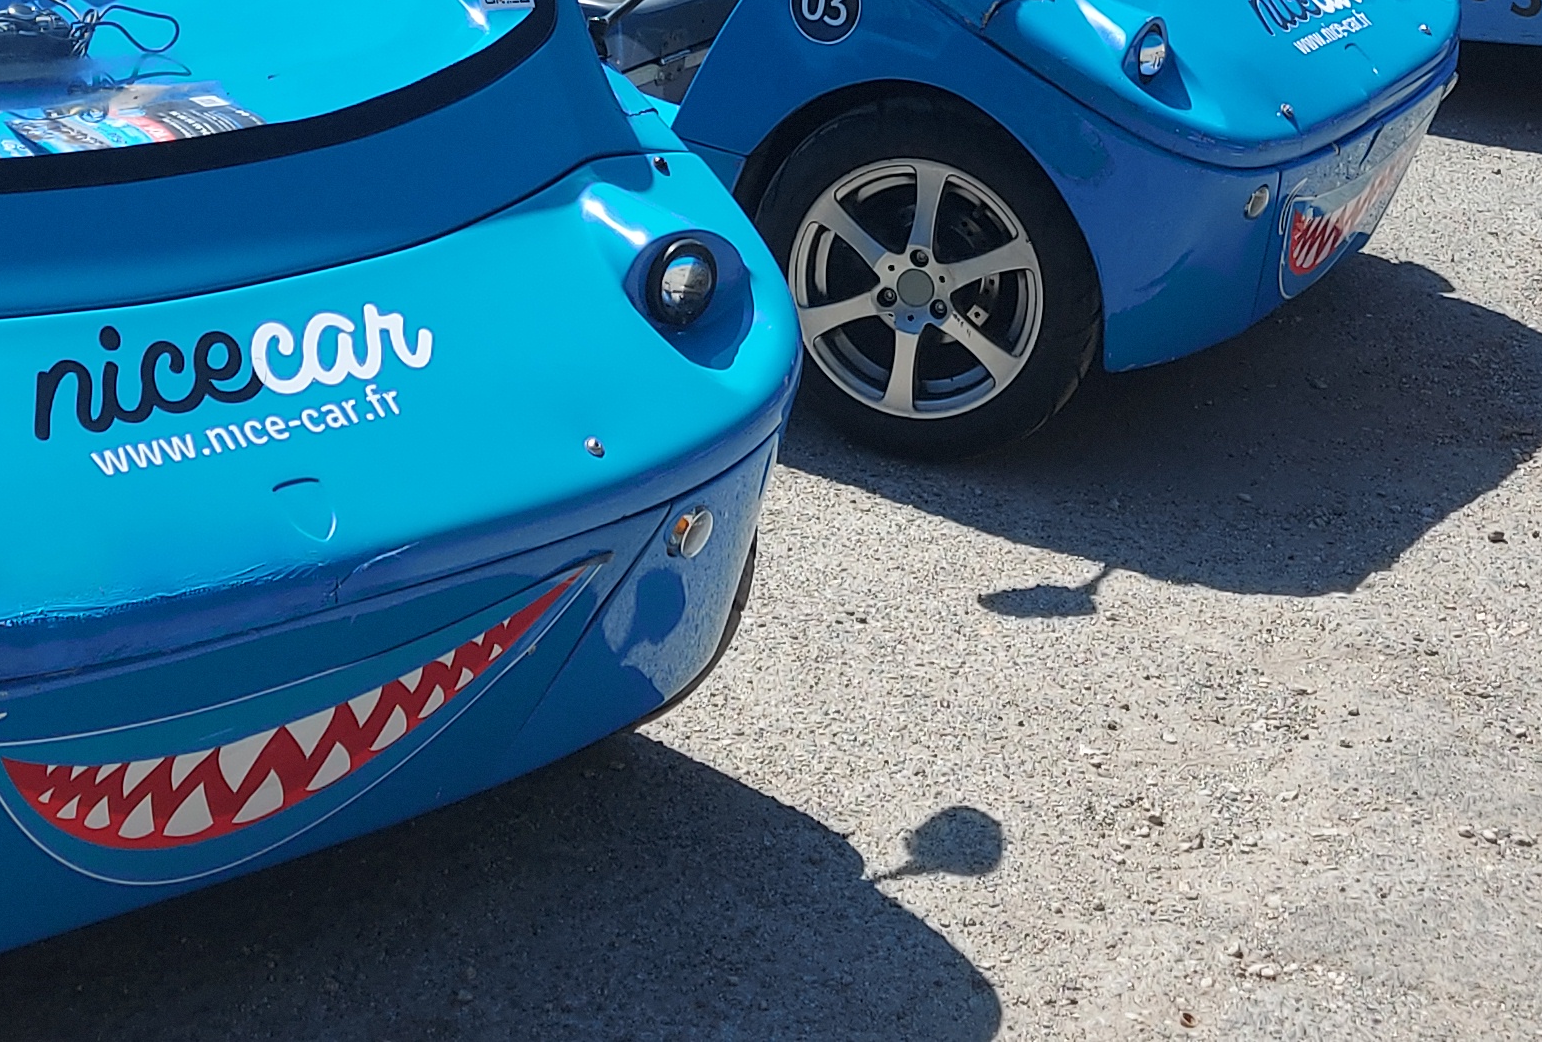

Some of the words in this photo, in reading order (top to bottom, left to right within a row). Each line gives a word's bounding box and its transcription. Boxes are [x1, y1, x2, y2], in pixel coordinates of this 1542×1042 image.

[1292, 9, 1373, 55] www.nice-car.fr
[33, 303, 434, 442] nicecar
[91, 384, 403, 476] www.nice-car.fr
